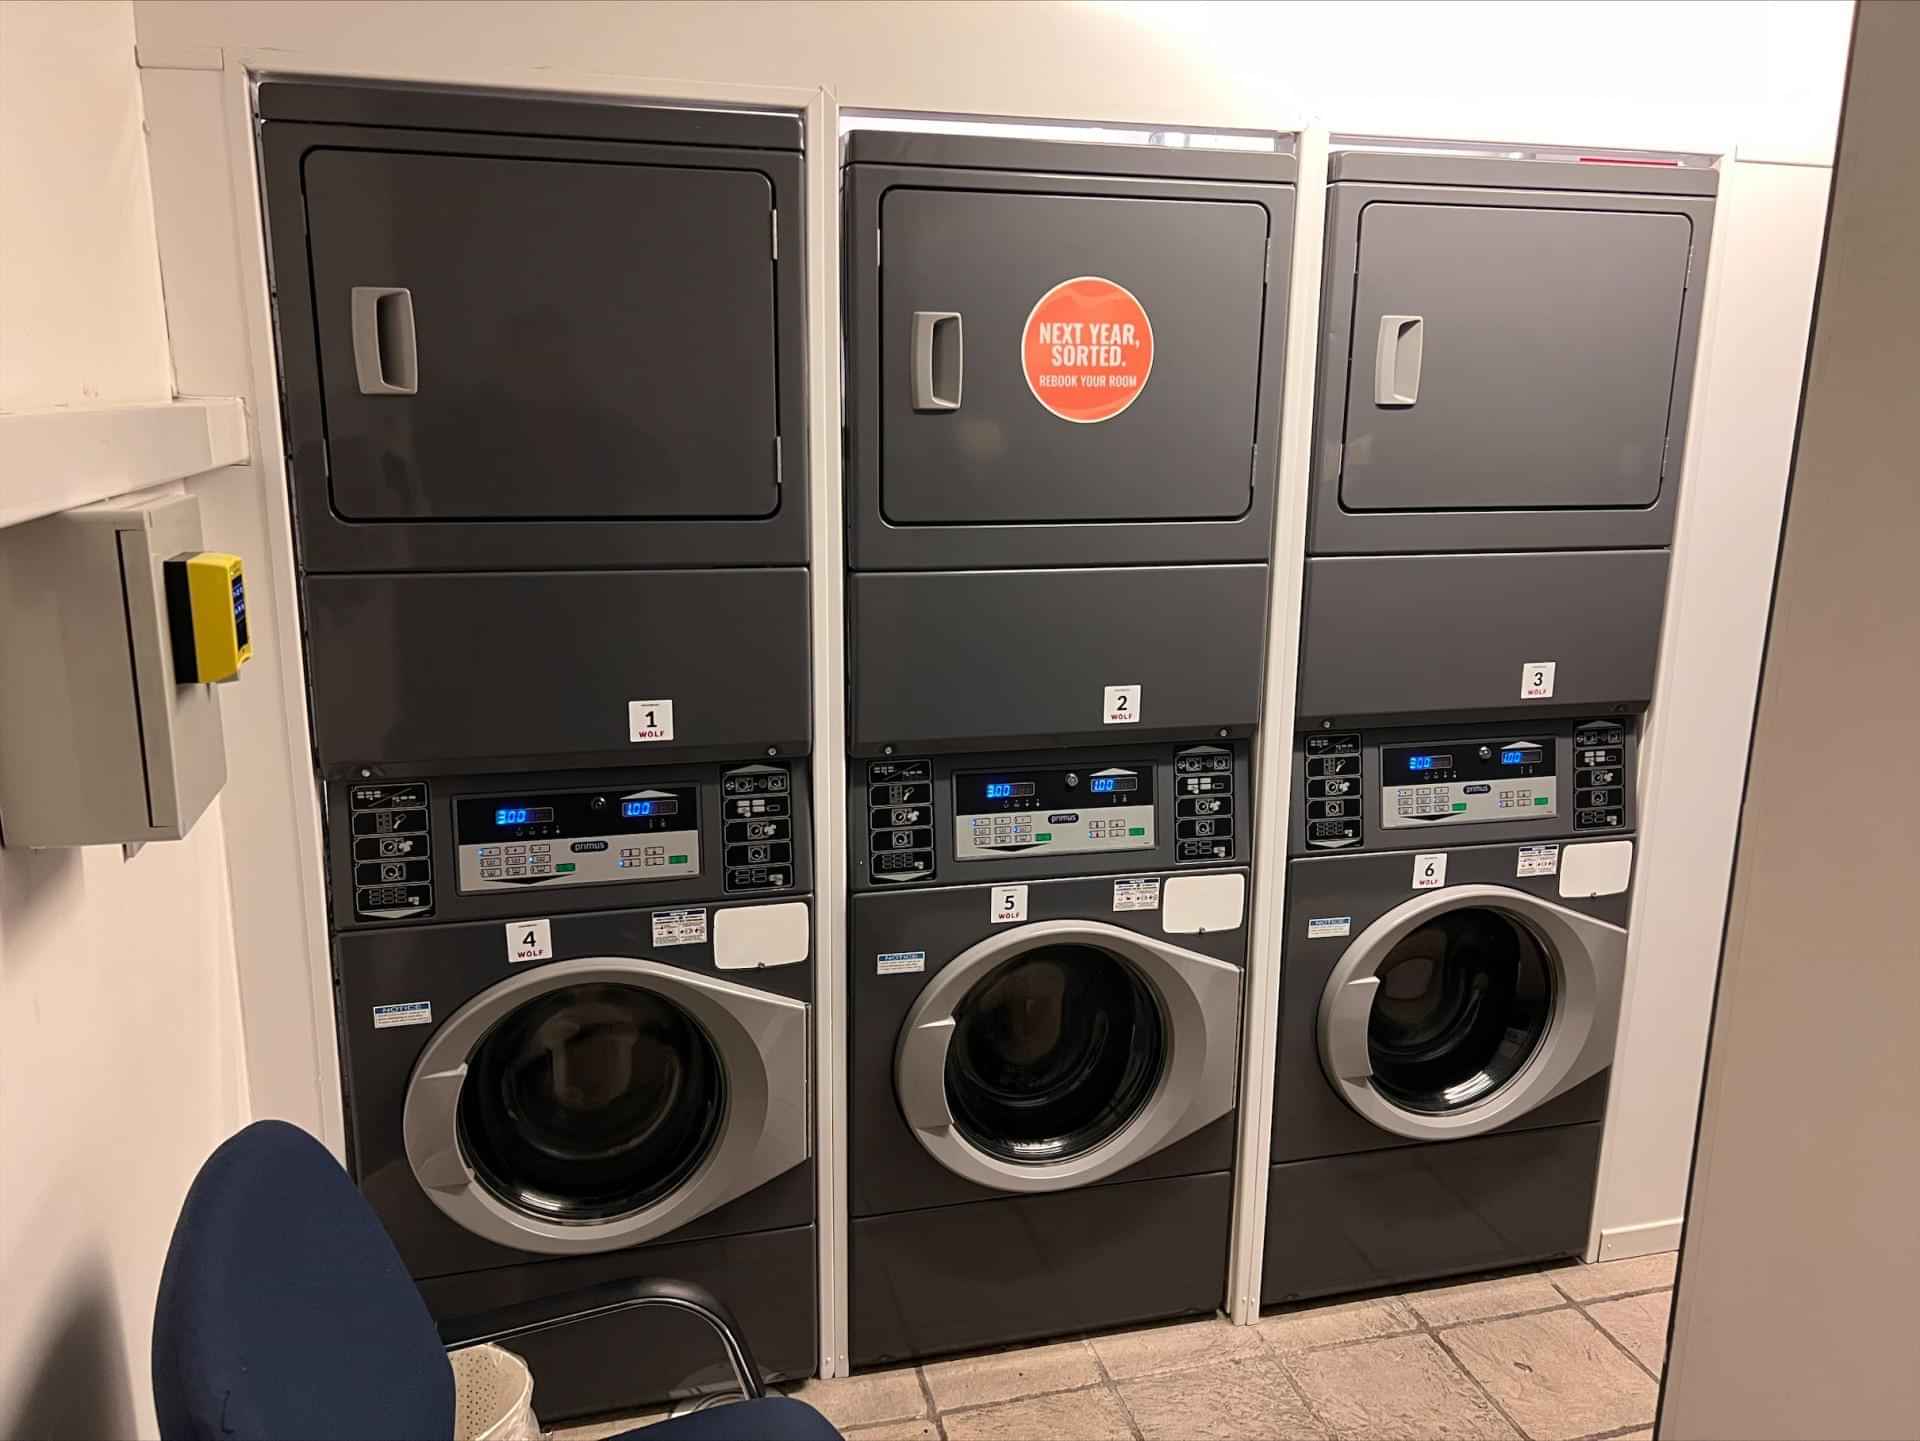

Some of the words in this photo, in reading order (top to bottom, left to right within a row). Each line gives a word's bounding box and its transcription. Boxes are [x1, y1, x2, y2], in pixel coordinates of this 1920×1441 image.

[1039, 322, 1083, 344] NEXT
[1089, 323, 1140, 348] YEAR,
[1051, 345, 1126, 367] SORTED.
[1039, 375, 1078, 387] REBOOK
[1080, 375, 1106, 387] YOUR
[1109, 375, 1137, 387] ROOM
[1534, 672, 1543, 686] 3
[1117, 696, 1128, 711] 2
[645, 711, 657, 727] 1
[638, 730, 664, 738] WOLF
[1051, 815, 1077, 824] primus
[574, 841, 606, 852] primus
[1425, 862, 1434, 877] 6
[1004, 895, 1015, 910] 5
[522, 931, 536, 947] 4
[517, 950, 544, 958] WOLF
